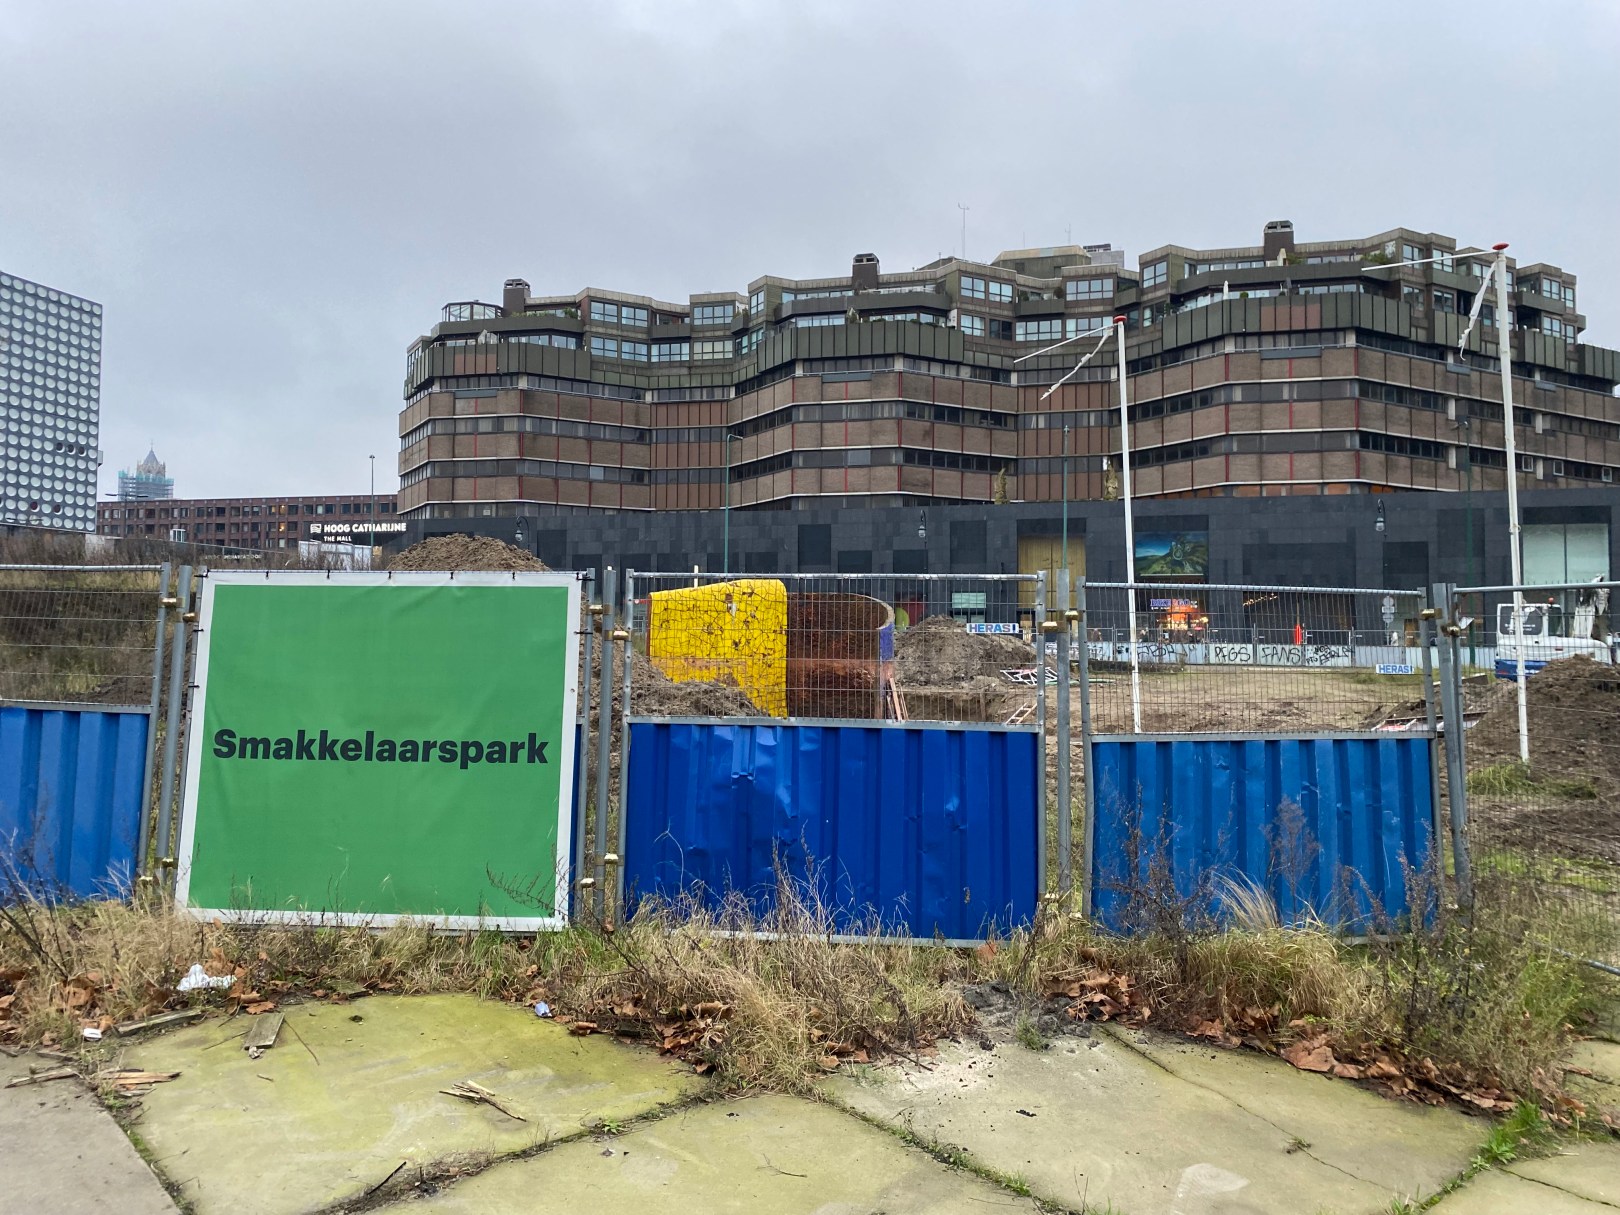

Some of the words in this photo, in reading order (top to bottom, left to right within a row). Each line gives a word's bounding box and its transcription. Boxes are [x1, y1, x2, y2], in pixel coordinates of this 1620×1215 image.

[324, 524, 350, 533] HOOG
[352, 523, 407, 532] CATHARIJNE
[969, 623, 1011, 633] HERAS
[1261, 646, 1301, 665] FANS
[1378, 664, 1410, 674] HERAS
[213, 729, 549, 769] Smakkelaarspark
